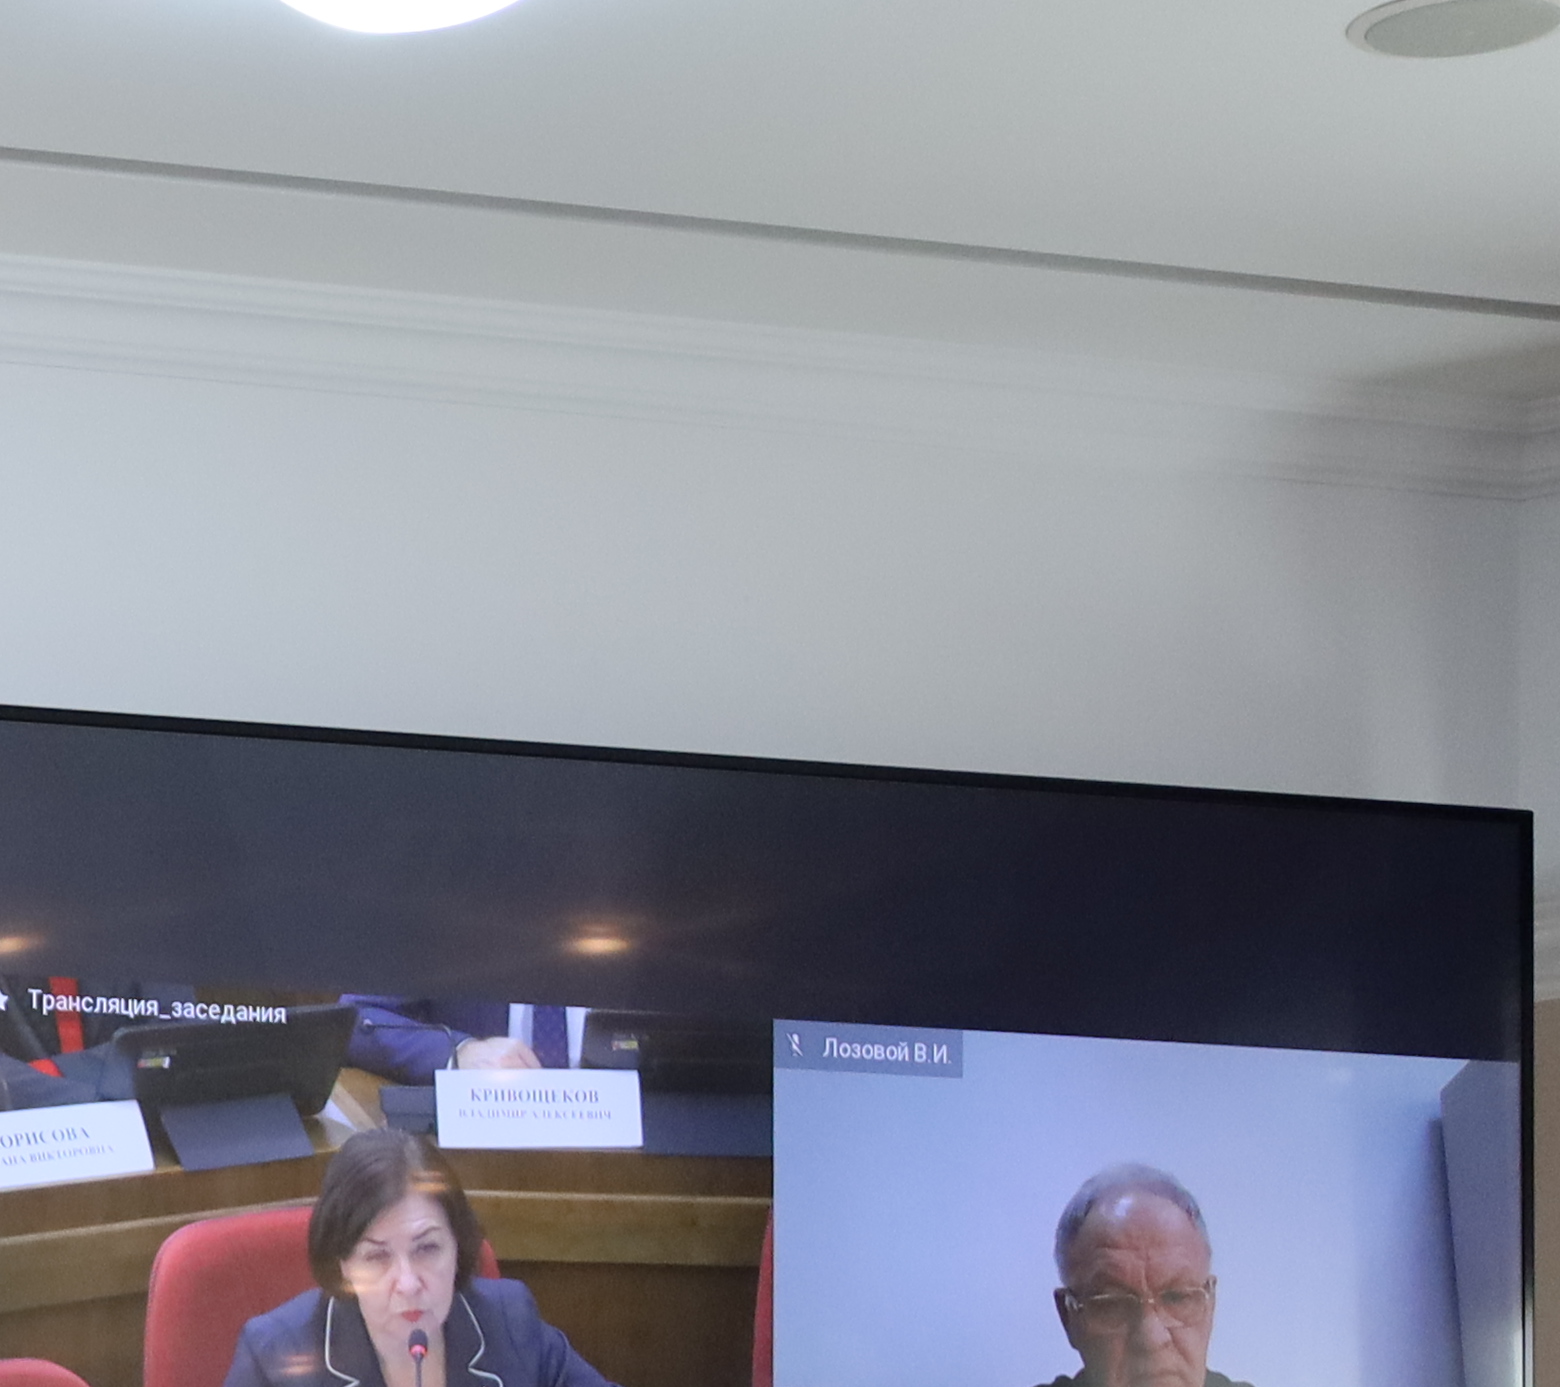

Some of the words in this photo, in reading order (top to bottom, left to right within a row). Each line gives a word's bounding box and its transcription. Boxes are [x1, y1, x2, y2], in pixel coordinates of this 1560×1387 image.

[27, 988, 287, 1024] Трансляция_заседания
[822, 1036, 910, 1062] Лозовой
[913, 1042, 952, 1065] В.И.
[470, 1087, 600, 1104] КРИВОЩЕКОВ
